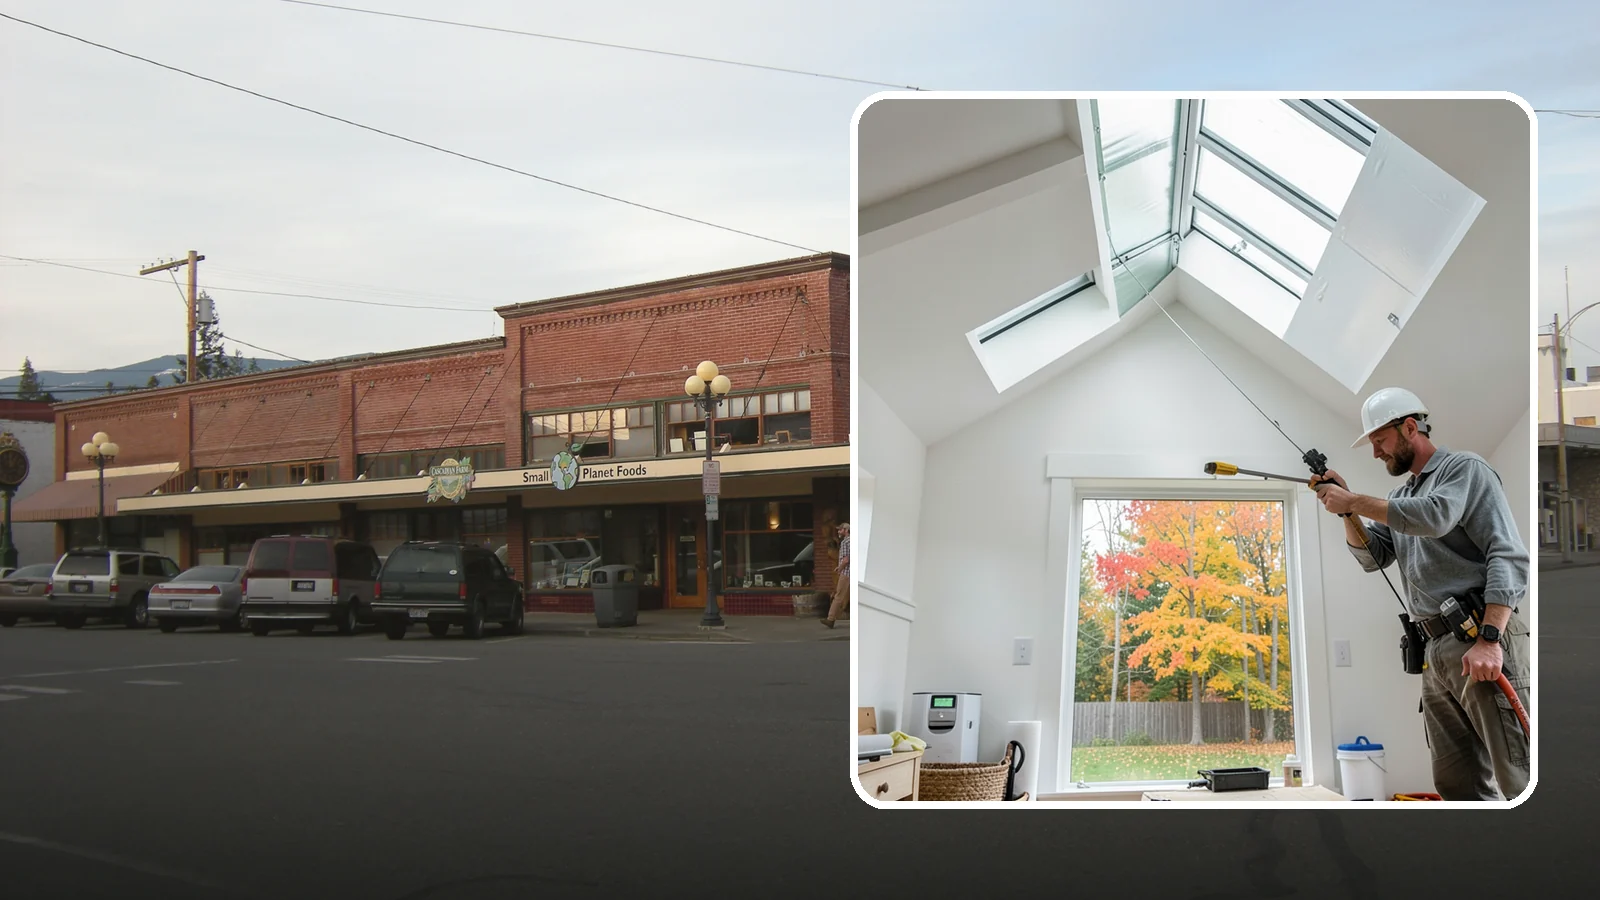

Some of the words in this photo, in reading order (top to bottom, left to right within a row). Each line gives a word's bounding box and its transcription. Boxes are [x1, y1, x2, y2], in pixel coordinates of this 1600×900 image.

[522, 470, 549, 484] Small
[582, 466, 614, 480] Planet
[617, 464, 647, 478] Foods
